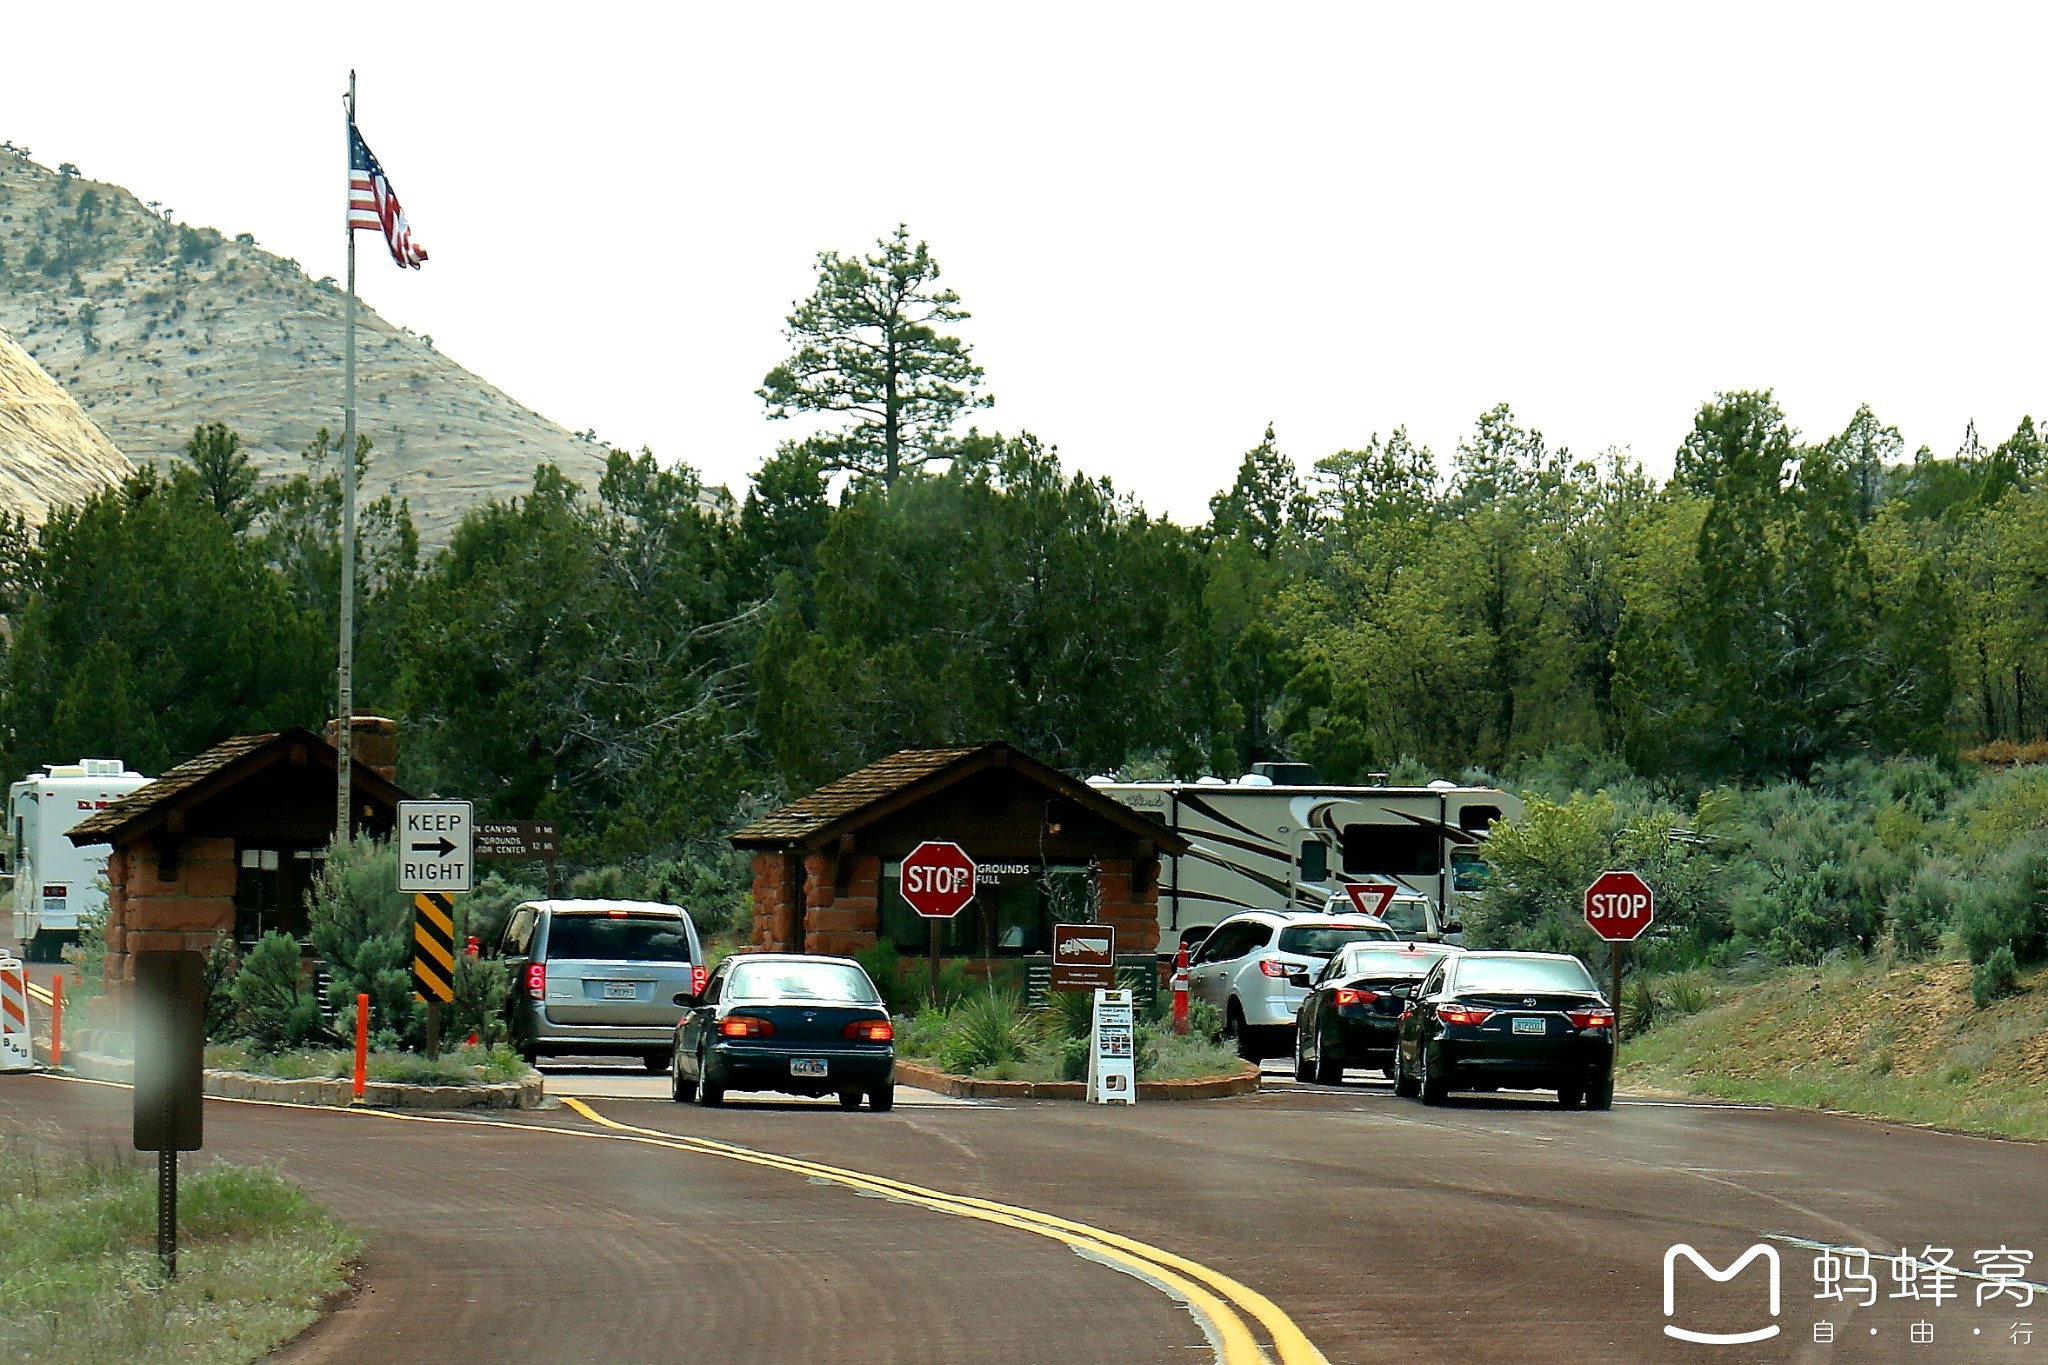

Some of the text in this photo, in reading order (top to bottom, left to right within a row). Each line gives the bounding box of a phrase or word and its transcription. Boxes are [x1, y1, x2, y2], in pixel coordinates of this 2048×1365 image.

[408, 815, 461, 831] KEEP
[484, 825, 518, 833] CANYON
[482, 837, 521, 845] GROUNDS
[496, 846, 527, 854] CENTER
[532, 842, 540, 850] 12
[404, 863, 465, 880] RIGHT
[976, 864, 1030, 874] GROUNDS
[907, 865, 969, 893] STOP
[976, 875, 1000, 884] FULL
[1590, 893, 1647, 919] STOP
